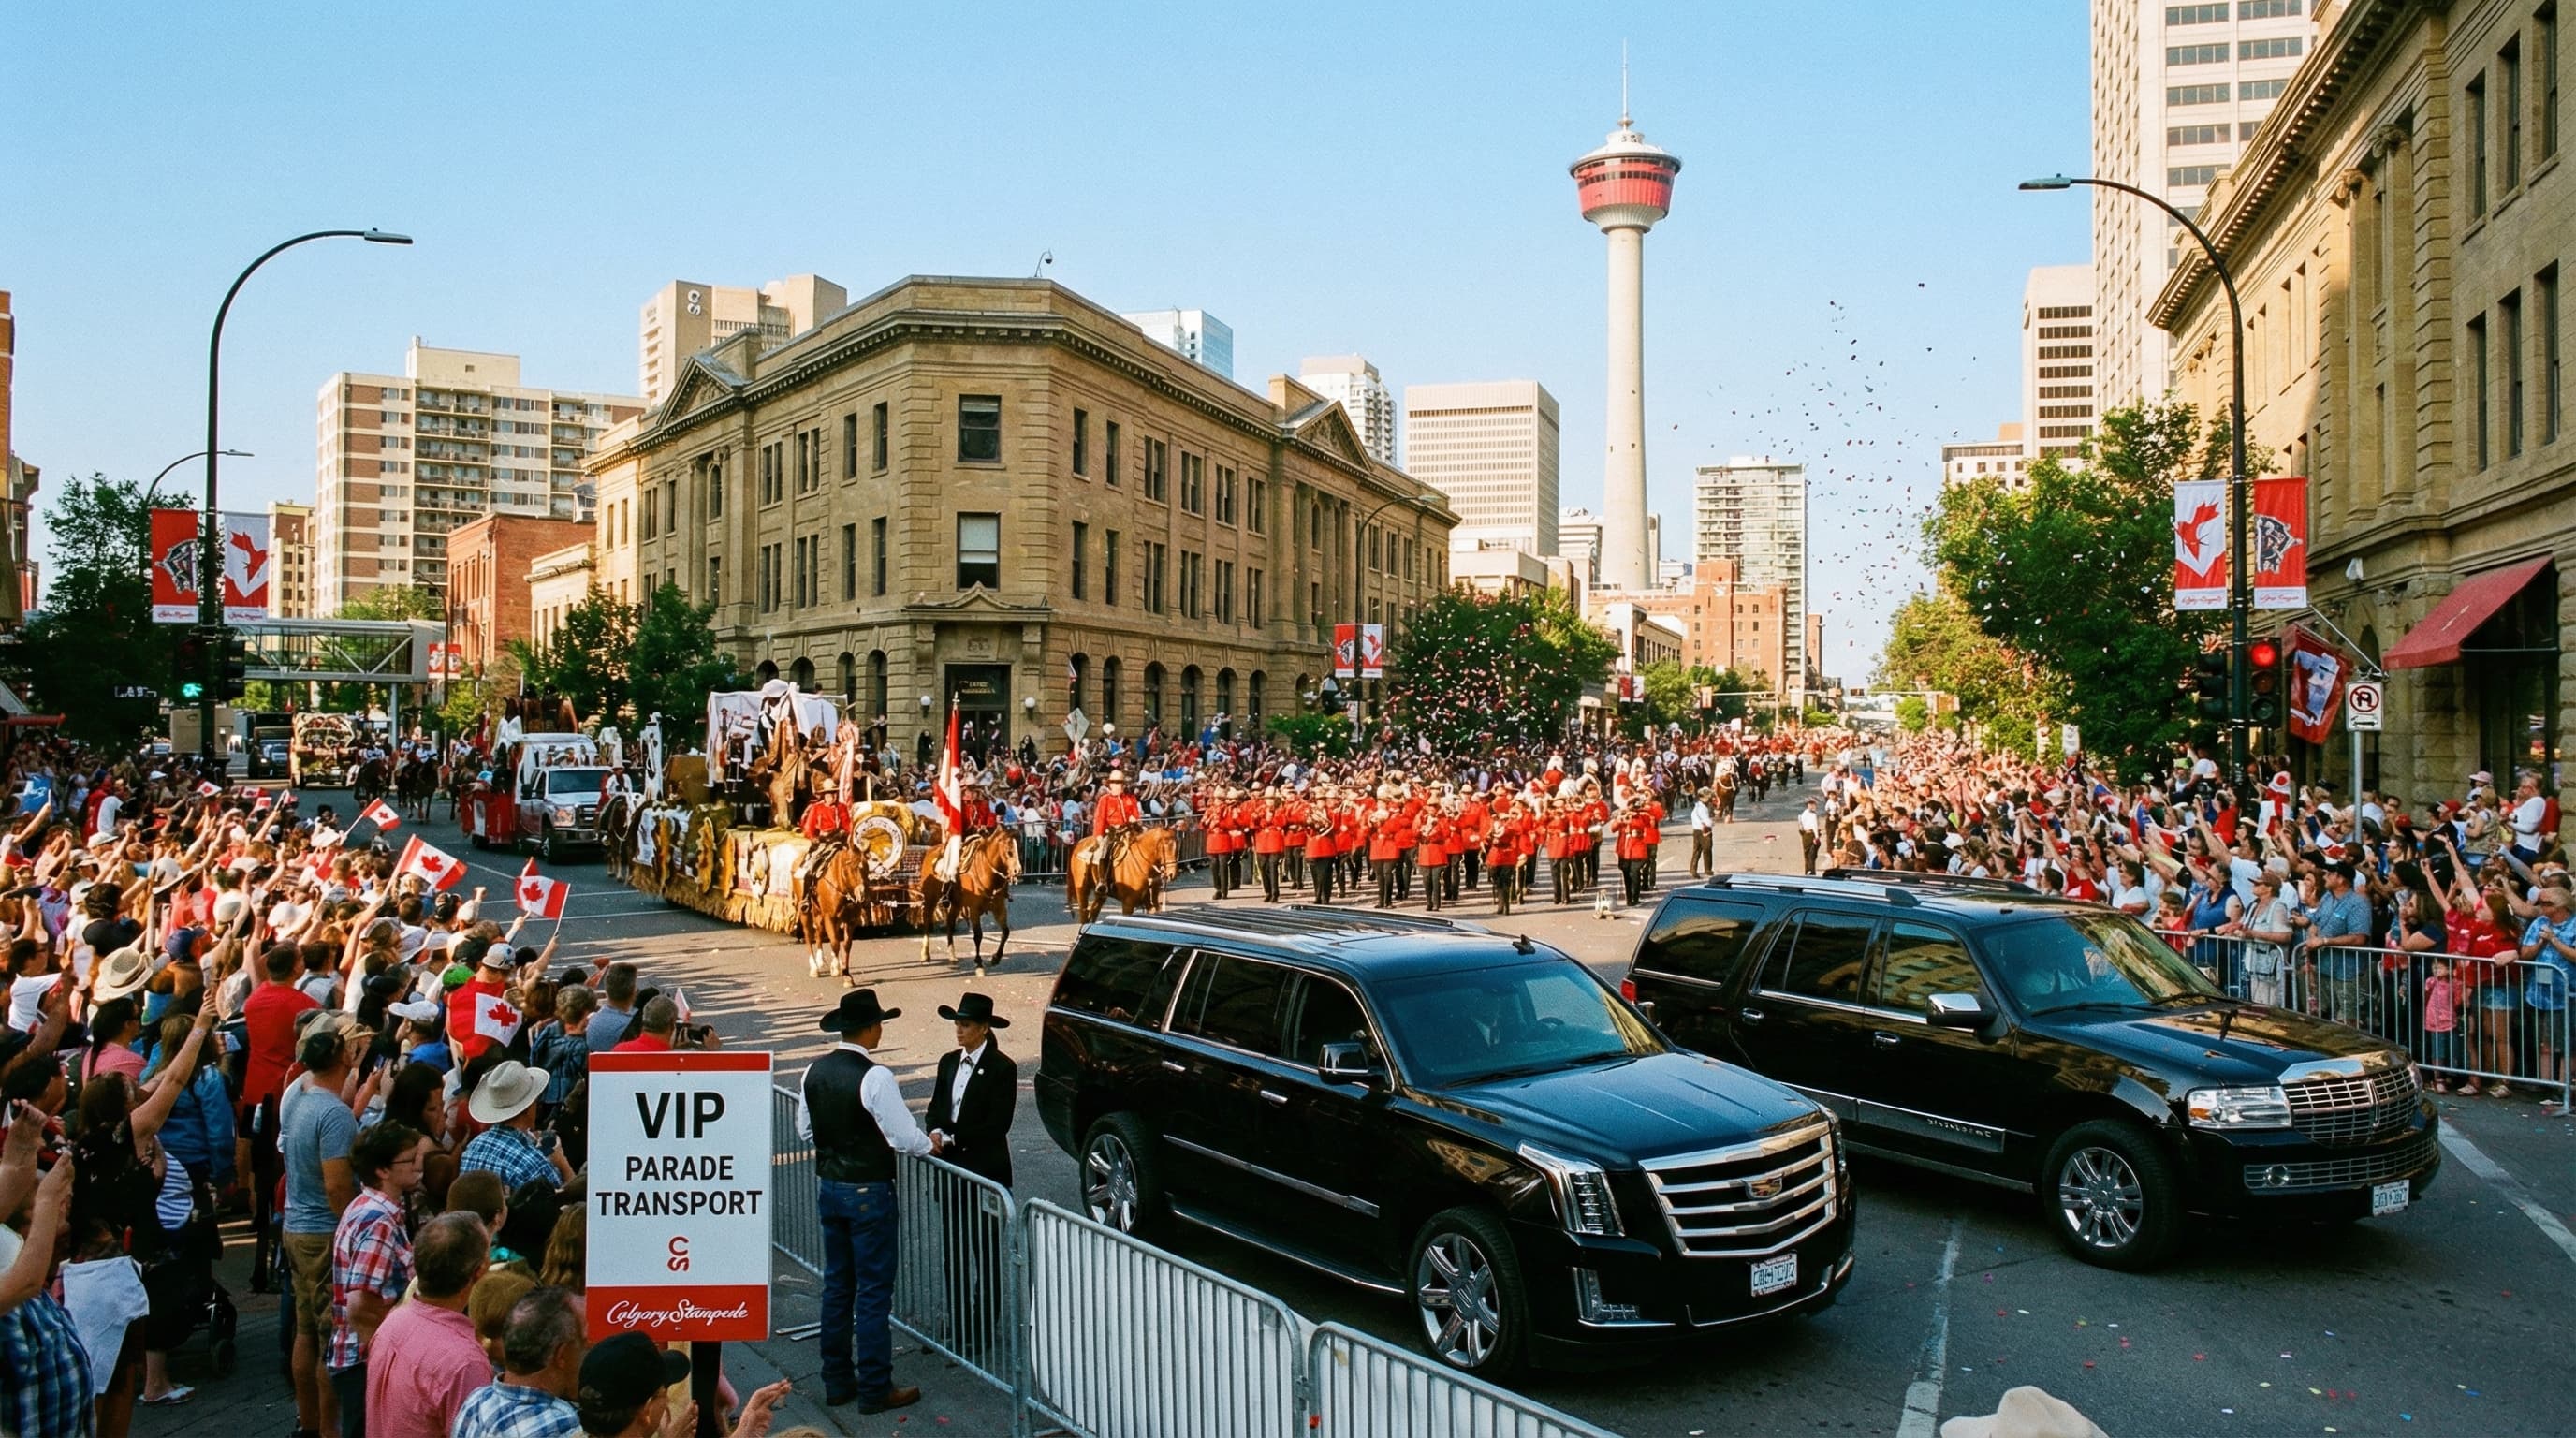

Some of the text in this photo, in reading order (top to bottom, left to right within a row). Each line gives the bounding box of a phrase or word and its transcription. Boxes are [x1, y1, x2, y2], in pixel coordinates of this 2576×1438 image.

[635, 1092, 725, 1139] VIP
[625, 1155, 734, 1181] PARADE
[595, 1190, 763, 1216] TRANSPORT
